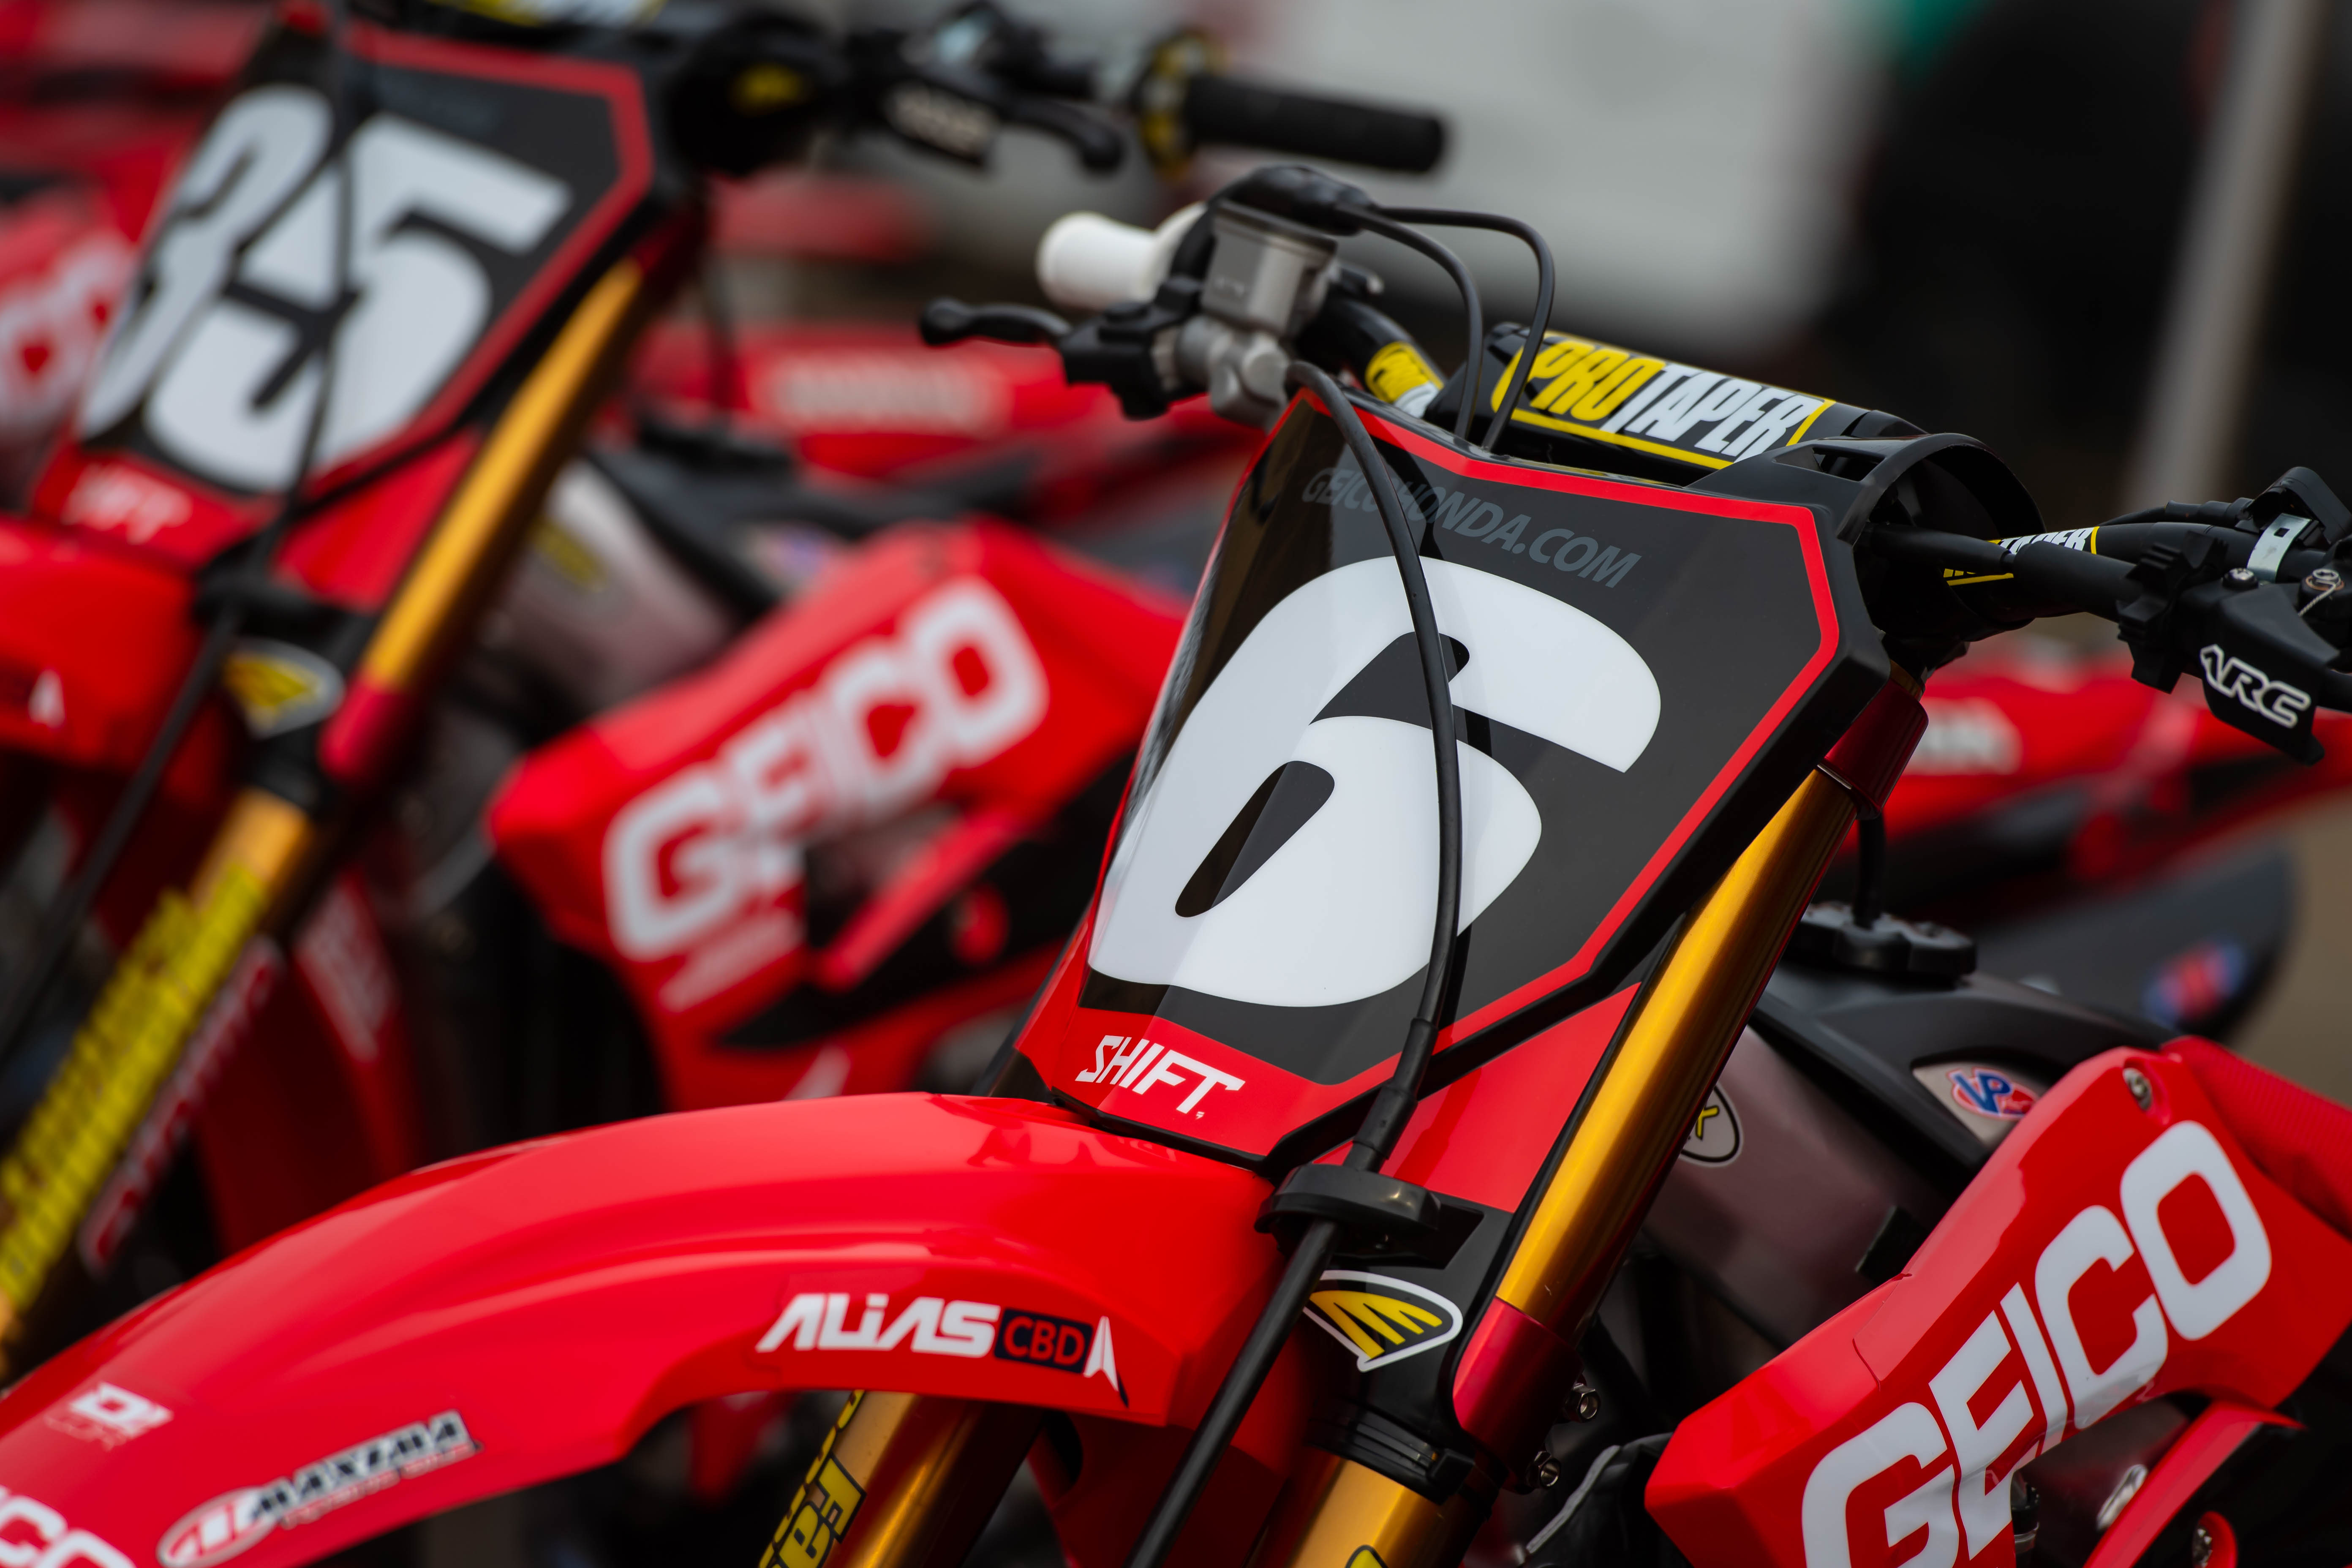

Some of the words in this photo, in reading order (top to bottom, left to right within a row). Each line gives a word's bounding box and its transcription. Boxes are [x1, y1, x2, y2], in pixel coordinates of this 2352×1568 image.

[77, 83, 574, 493] 35
[1089, 555, 1661, 1007] 6
[1075, 1034, 1245, 1114] SHIFT
[1002, 1317, 1086, 1367] CBD
[1802, 1120, 2272, 1568] GEICO
